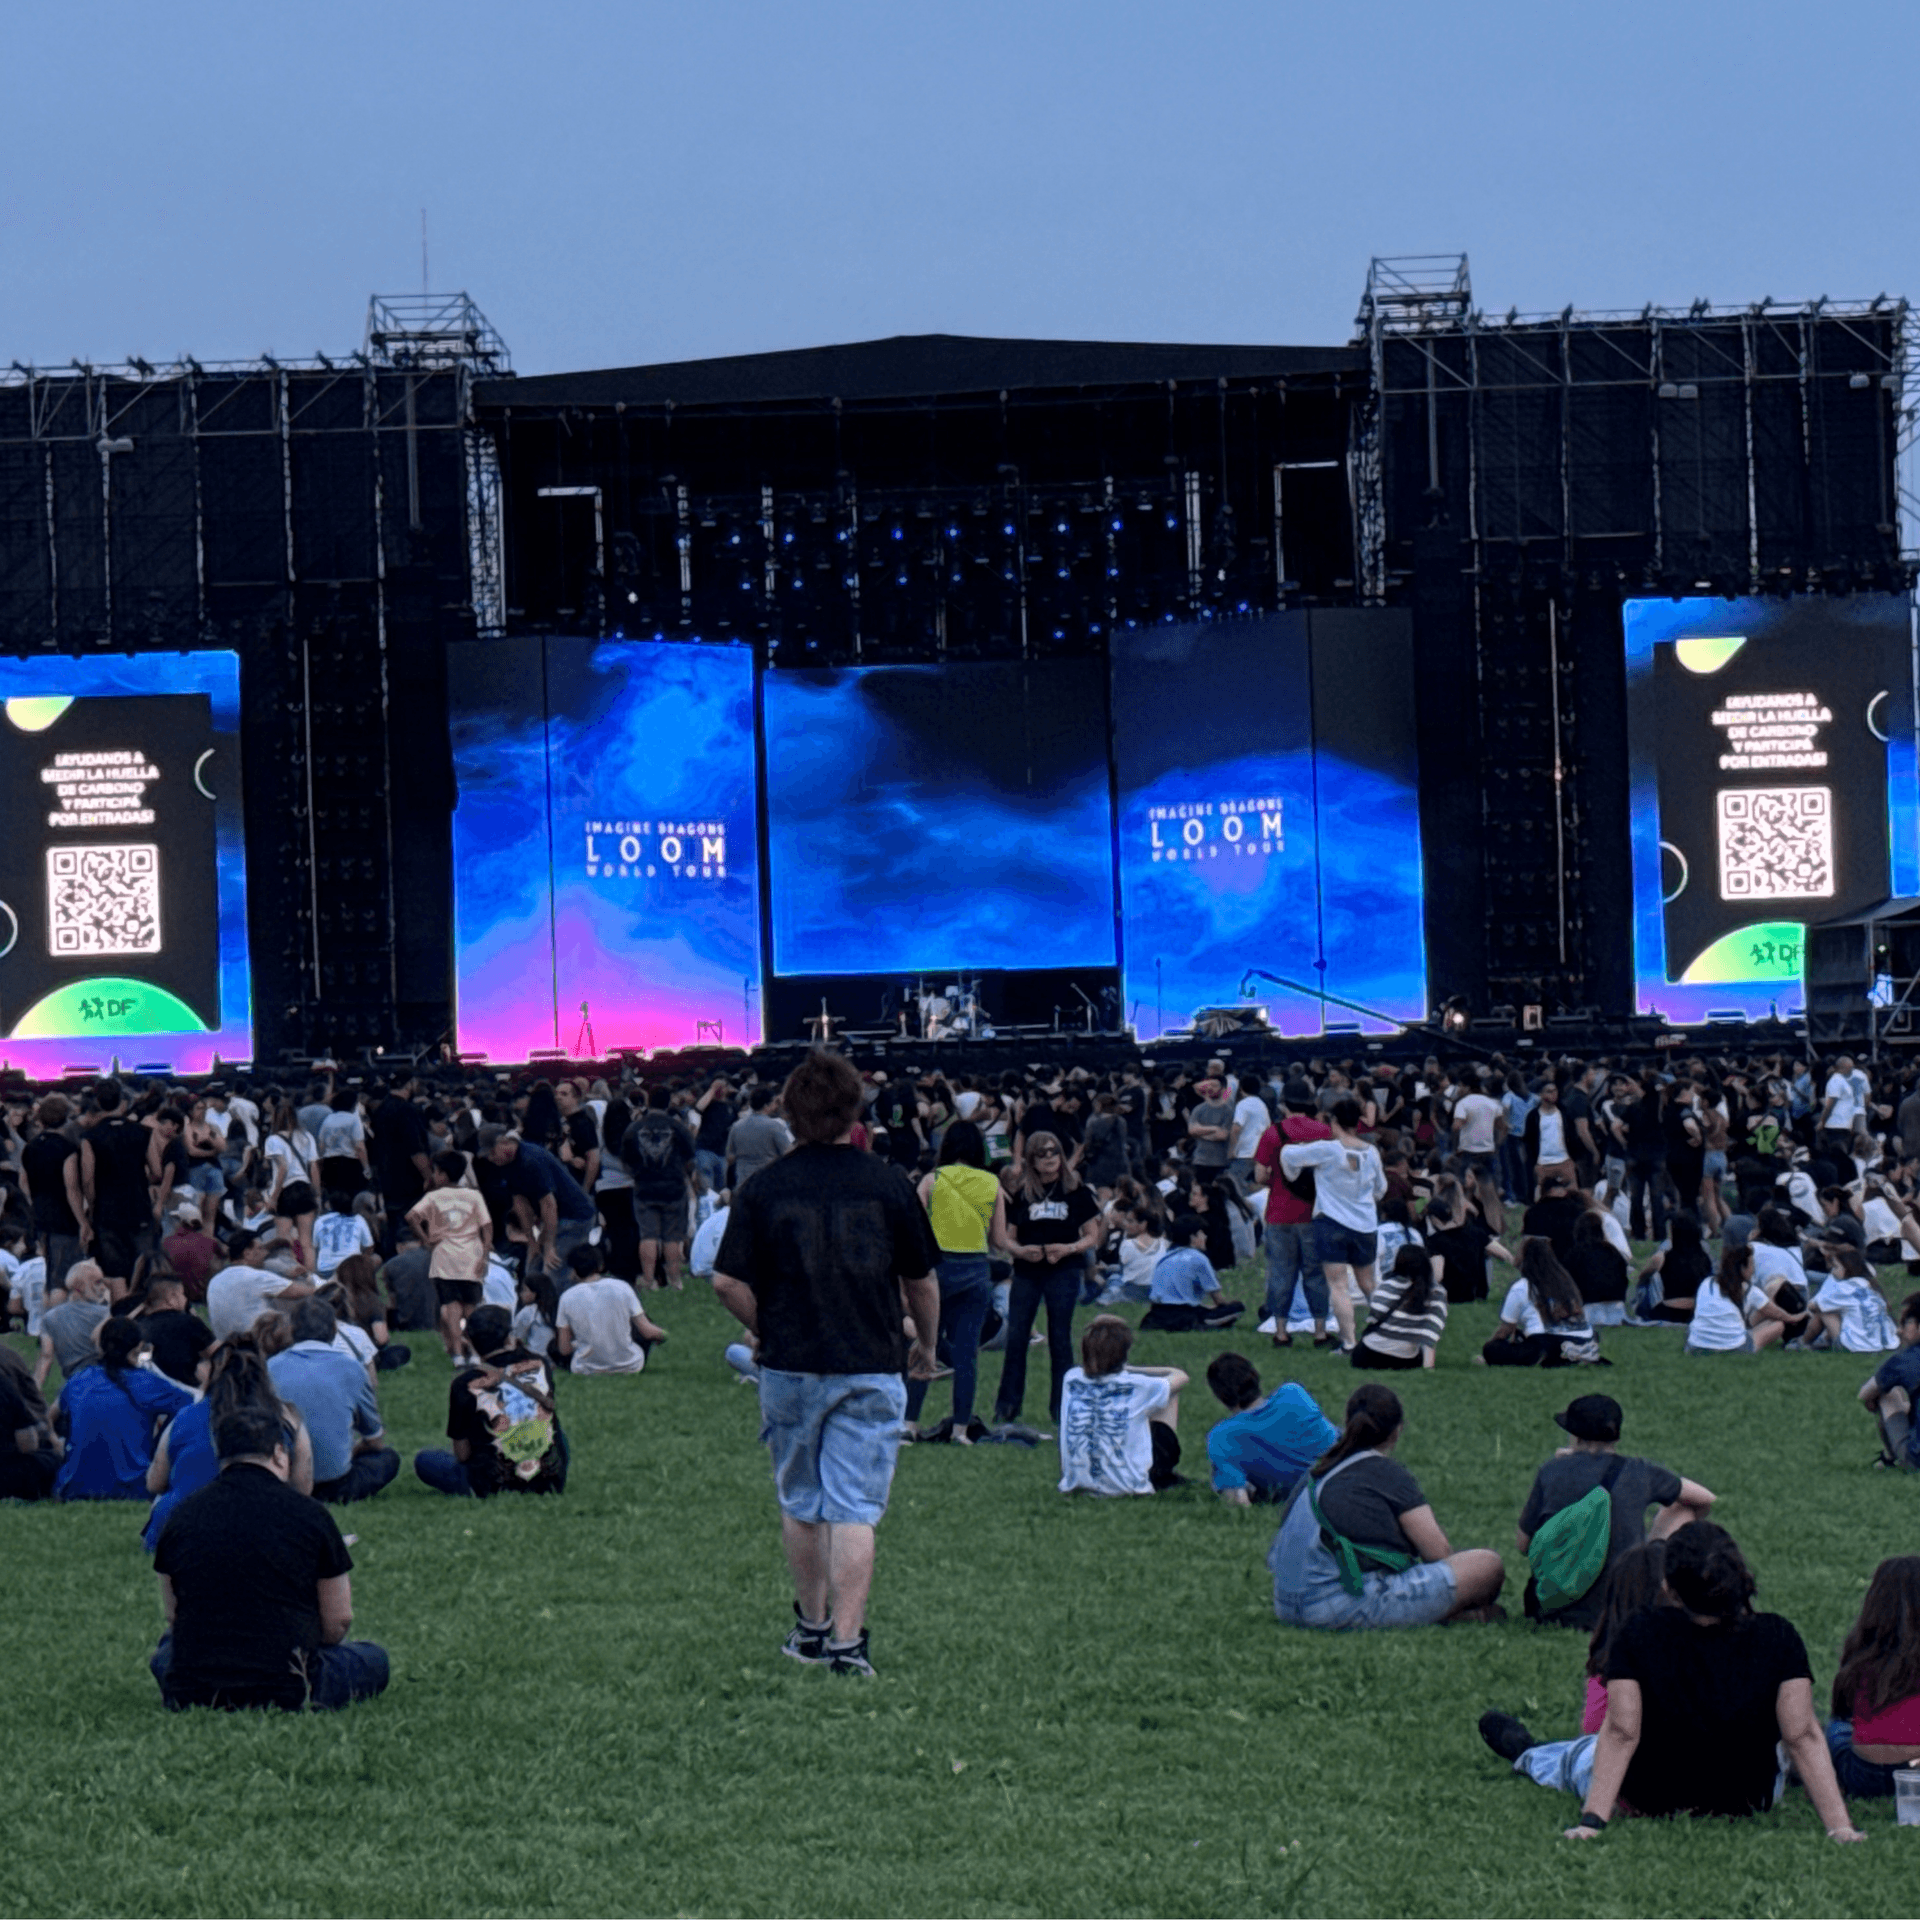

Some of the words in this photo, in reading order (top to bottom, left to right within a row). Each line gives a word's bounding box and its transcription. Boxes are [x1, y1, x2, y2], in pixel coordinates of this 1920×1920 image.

[1805, 692, 1818, 707] A
[1758, 710, 1776, 723] LA
[1777, 706, 1833, 723] HUELLA
[1728, 726, 1747, 740] DE
[1749, 724, 1818, 739] CARBONO
[1731, 741, 1743, 753] Y
[133, 750, 145, 764] A
[1719, 754, 1749, 770] POR
[41, 768, 85, 783] MEDIR
[87, 768, 104, 780] LA
[106, 764, 160, 780] HUELLA
[57, 783, 76, 797] DE
[78, 782, 146, 796] CARBONO
[61, 798, 72, 811] Y
[1149, 802, 1213, 820] IMAGINE
[1219, 797, 1283, 815] DRAGONS
[48, 812, 79, 827] POR
[585, 821, 651, 835] IMAGINE
[657, 821, 725, 836] DRAGONS
[1151, 811, 1283, 848] LOOM
[586, 834, 726, 864] LOOM
[1233, 839, 1284, 857] TOUR
[586, 864, 656, 878] WORLD
[672, 864, 726, 878] TOUR
[107, 998, 136, 1017] DF
